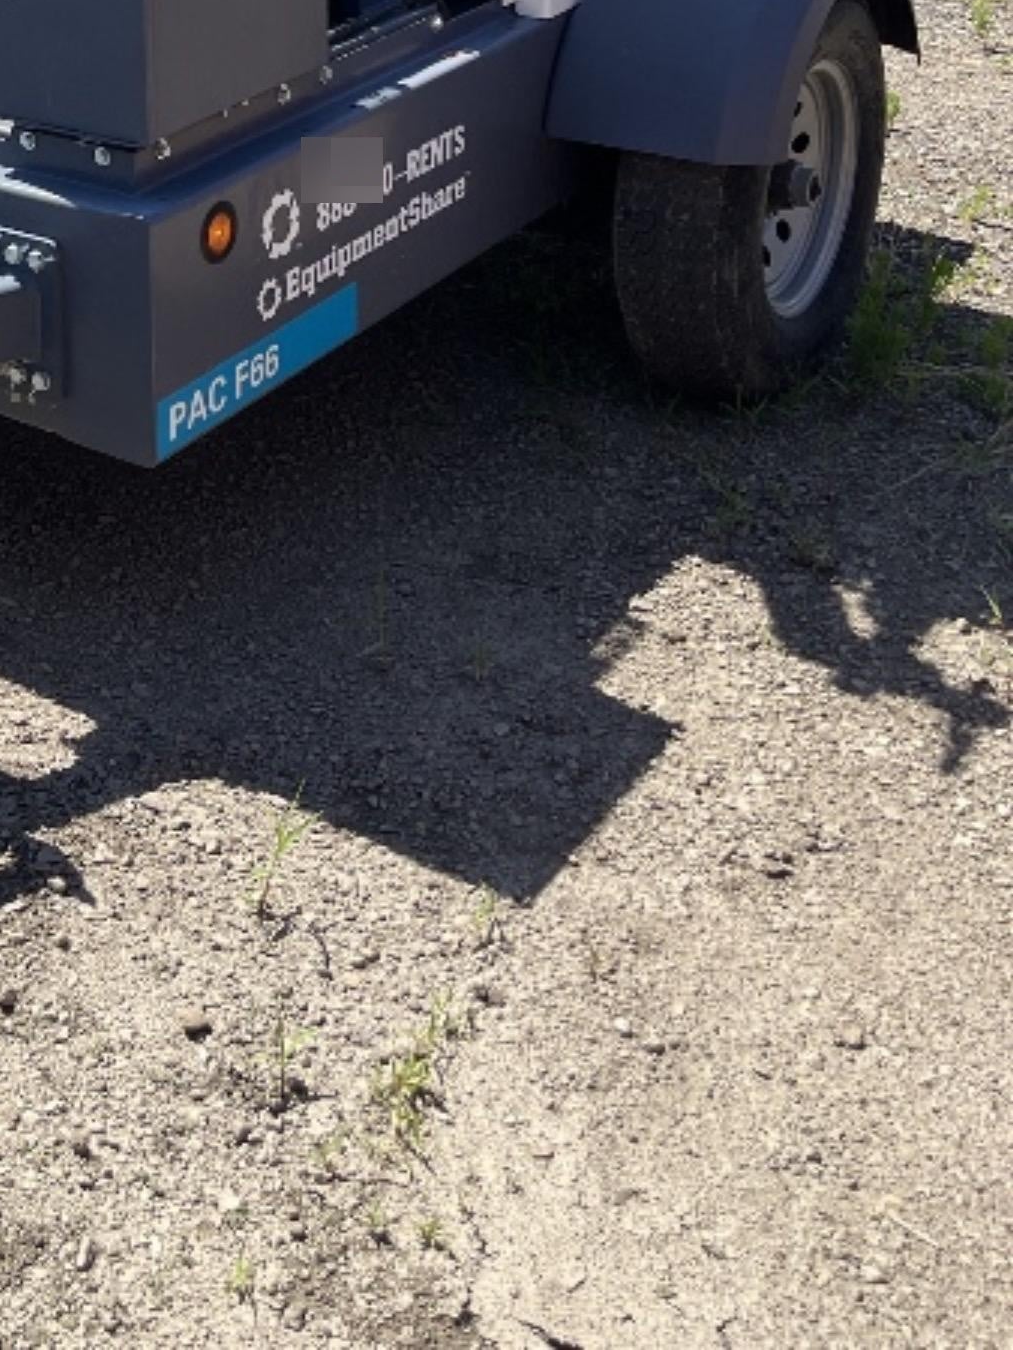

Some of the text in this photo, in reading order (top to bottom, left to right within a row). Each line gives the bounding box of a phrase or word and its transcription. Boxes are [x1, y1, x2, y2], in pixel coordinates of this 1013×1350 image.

[283, 176, 466, 303] EquipmentShare
[169, 344, 279, 441] PAC F66
